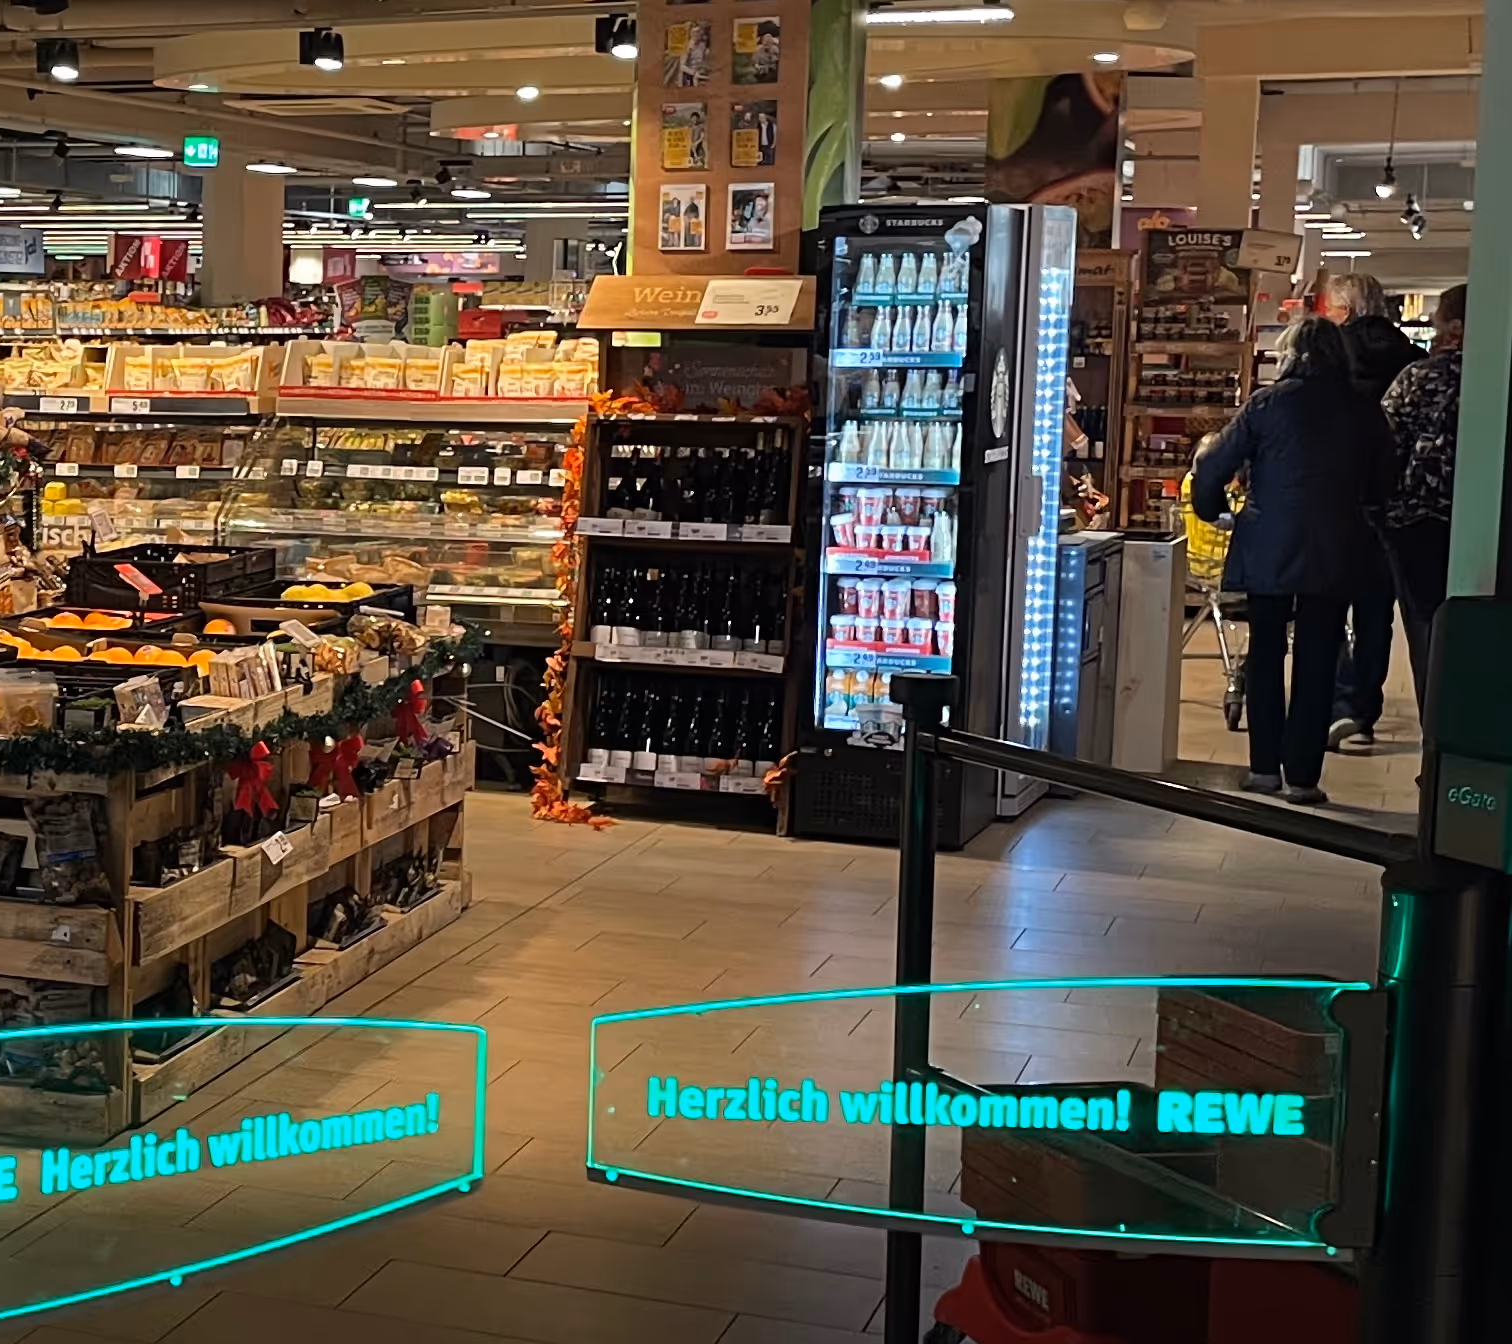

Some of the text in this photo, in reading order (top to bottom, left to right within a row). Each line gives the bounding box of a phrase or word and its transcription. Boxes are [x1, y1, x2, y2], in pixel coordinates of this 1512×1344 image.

[1168, 234, 1233, 248] LOUISE'S
[634, 285, 701, 304] Wein
[1448, 786, 1496, 811] eGate
[646, 1076, 1306, 1137] Herzlich willkommen! REWE
[40, 1128, 201, 1195] Herzlich
[207, 1092, 440, 1168] willkommen!
[1013, 1268, 1050, 1312] REWE
